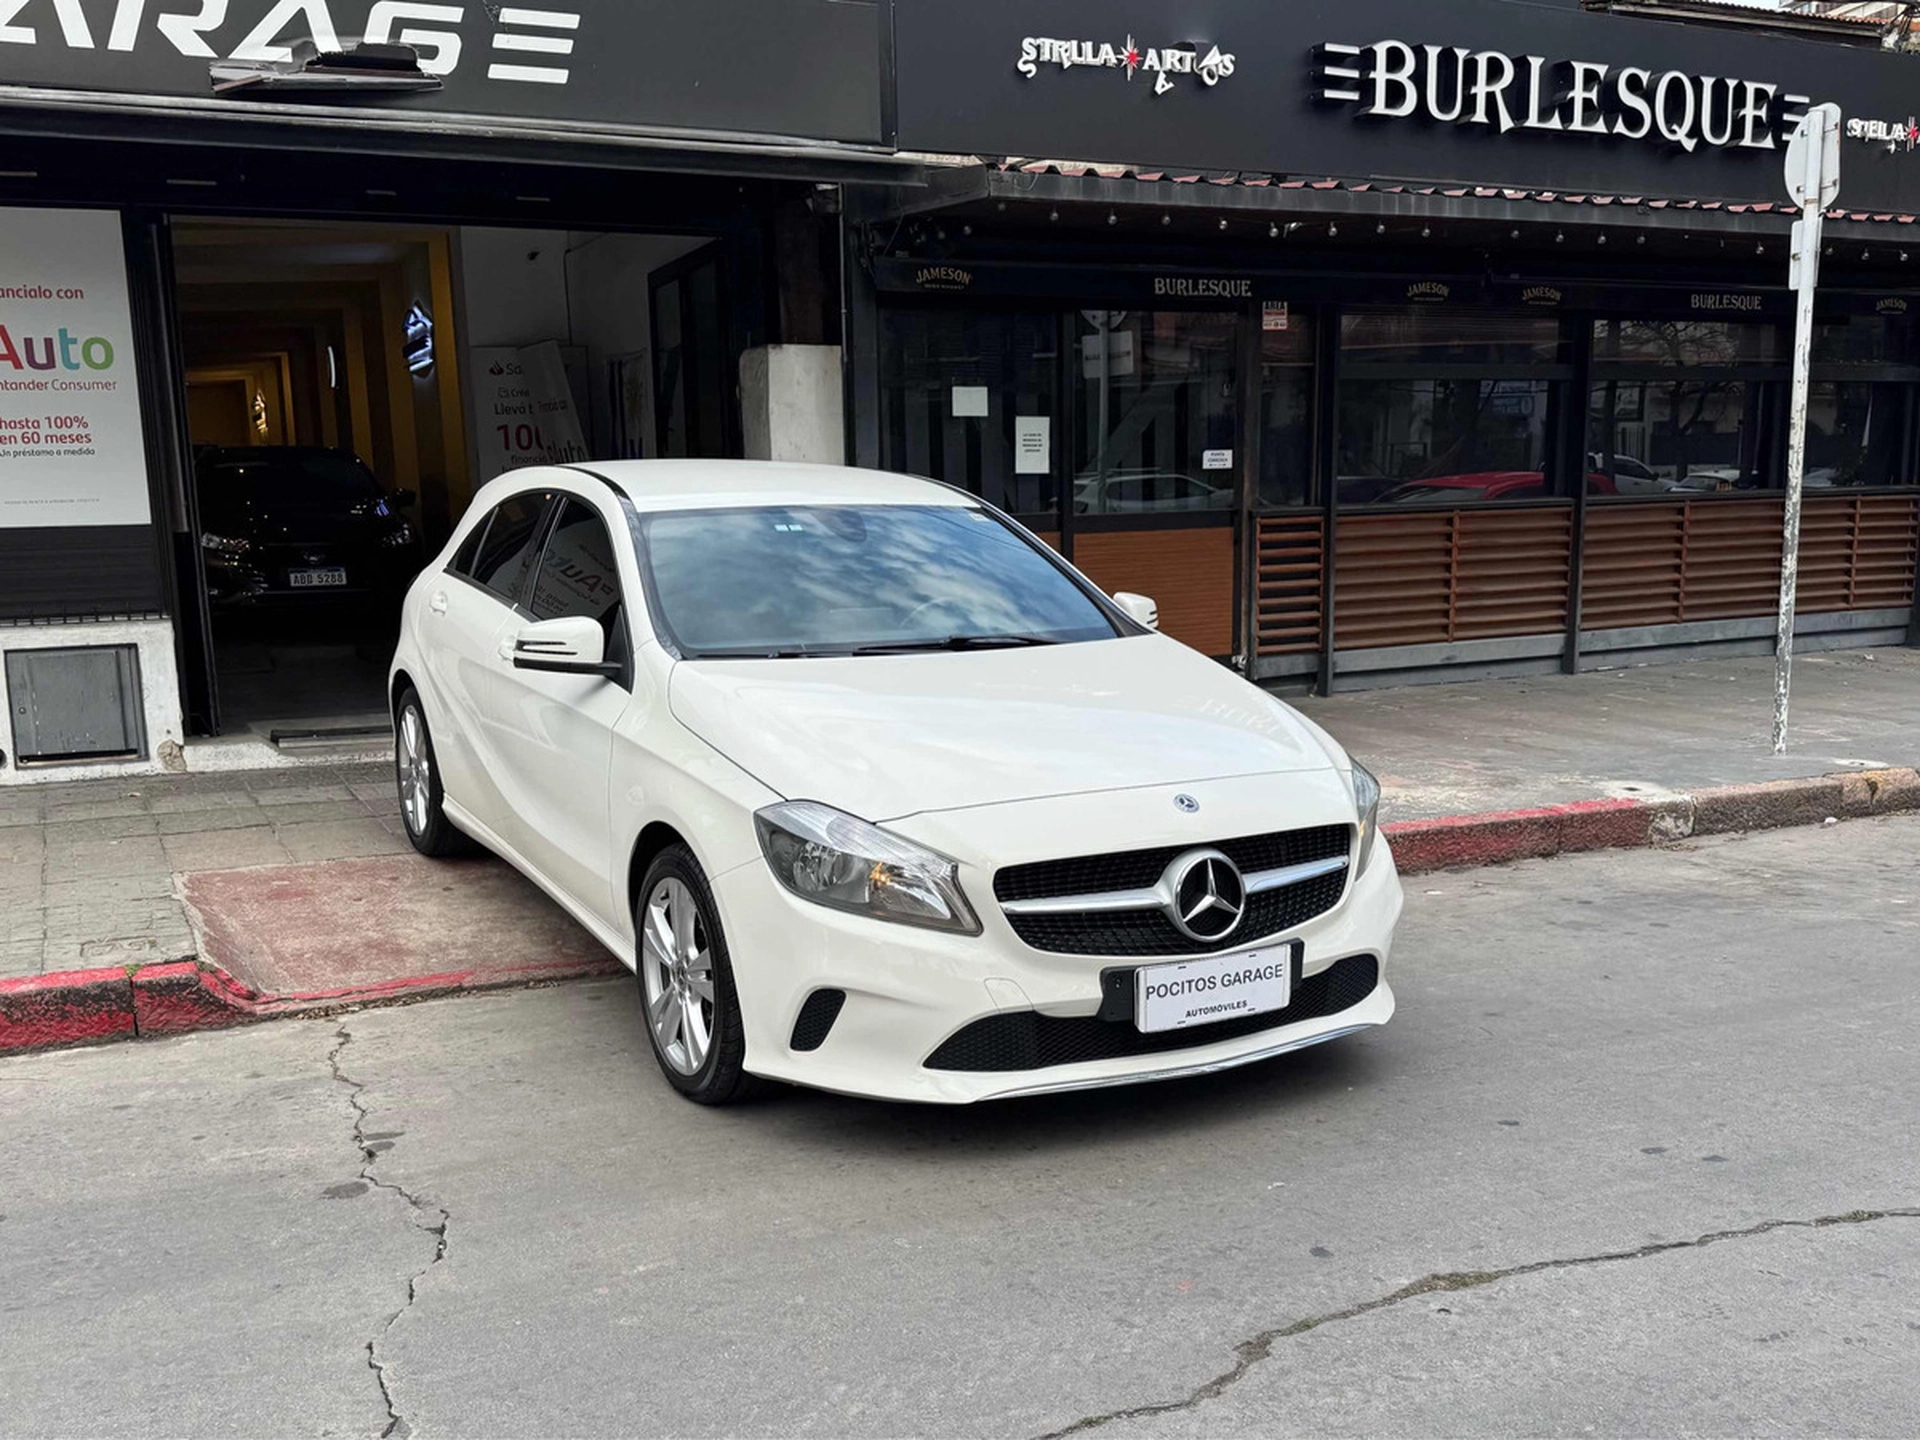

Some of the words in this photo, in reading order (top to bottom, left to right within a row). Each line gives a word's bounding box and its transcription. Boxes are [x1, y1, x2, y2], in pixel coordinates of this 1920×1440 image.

[1367, 38, 1778, 153] BURLESQUE
[916, 266, 972, 286] JAMESON
[56, 289, 84, 299] con
[1154, 277, 1252, 298] BURLESQUE
[1407, 281, 1450, 298] JAMESON
[1522, 286, 1563, 302] JAMESON
[1691, 294, 1762, 311] BURLESQUE
[0, 325, 114, 370] Auto
[51, 379, 117, 391] Consumer
[0, 416, 41, 430] hasta
[45, 415, 89, 430] 100%
[0, 434, 17, 445] en
[21, 431, 41, 445] 60
[44, 433, 92, 444] meses
[63, 447, 96, 456] medida
[1146, 975, 1217, 1000] POCITOS
[1221, 963, 1284, 988] GARAGE
